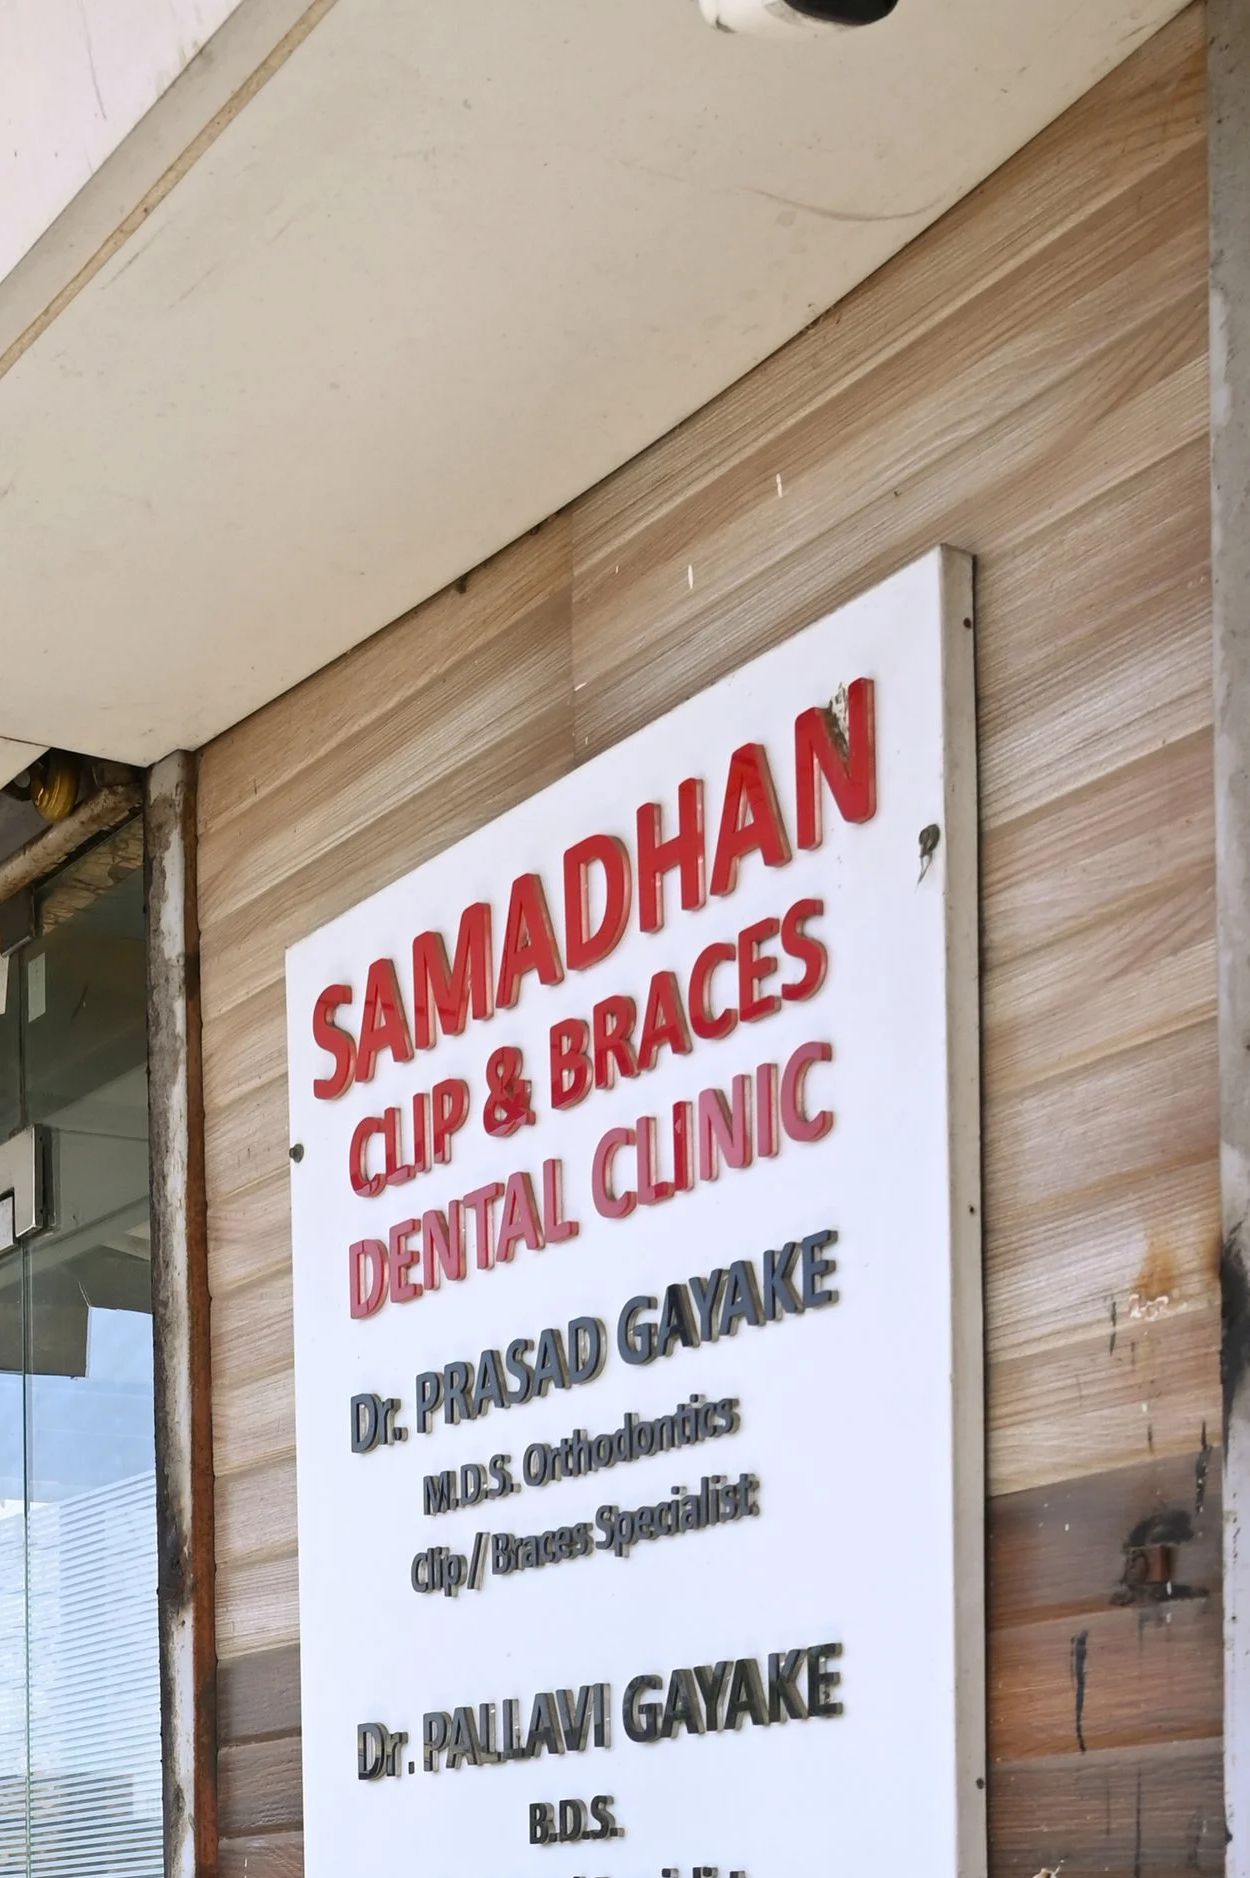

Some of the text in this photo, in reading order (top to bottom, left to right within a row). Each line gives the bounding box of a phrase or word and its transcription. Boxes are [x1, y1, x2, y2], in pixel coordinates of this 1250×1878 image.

[313, 677, 876, 1100] SAMADHAN
[350, 898, 827, 1197] CLIP & BRACES
[350, 1042, 834, 1319] DENTAL CLINIC
[351, 1229, 839, 1453] Dr. PRASAD GAYAKE
[423, 1393, 740, 1516] M.D.S. Orthodontics
[595, 1473, 760, 1558] Specialist
[357, 1643, 844, 1780] Dr. PALLAVI GAYAKE
[529, 1795, 625, 1845] B.D.S.
